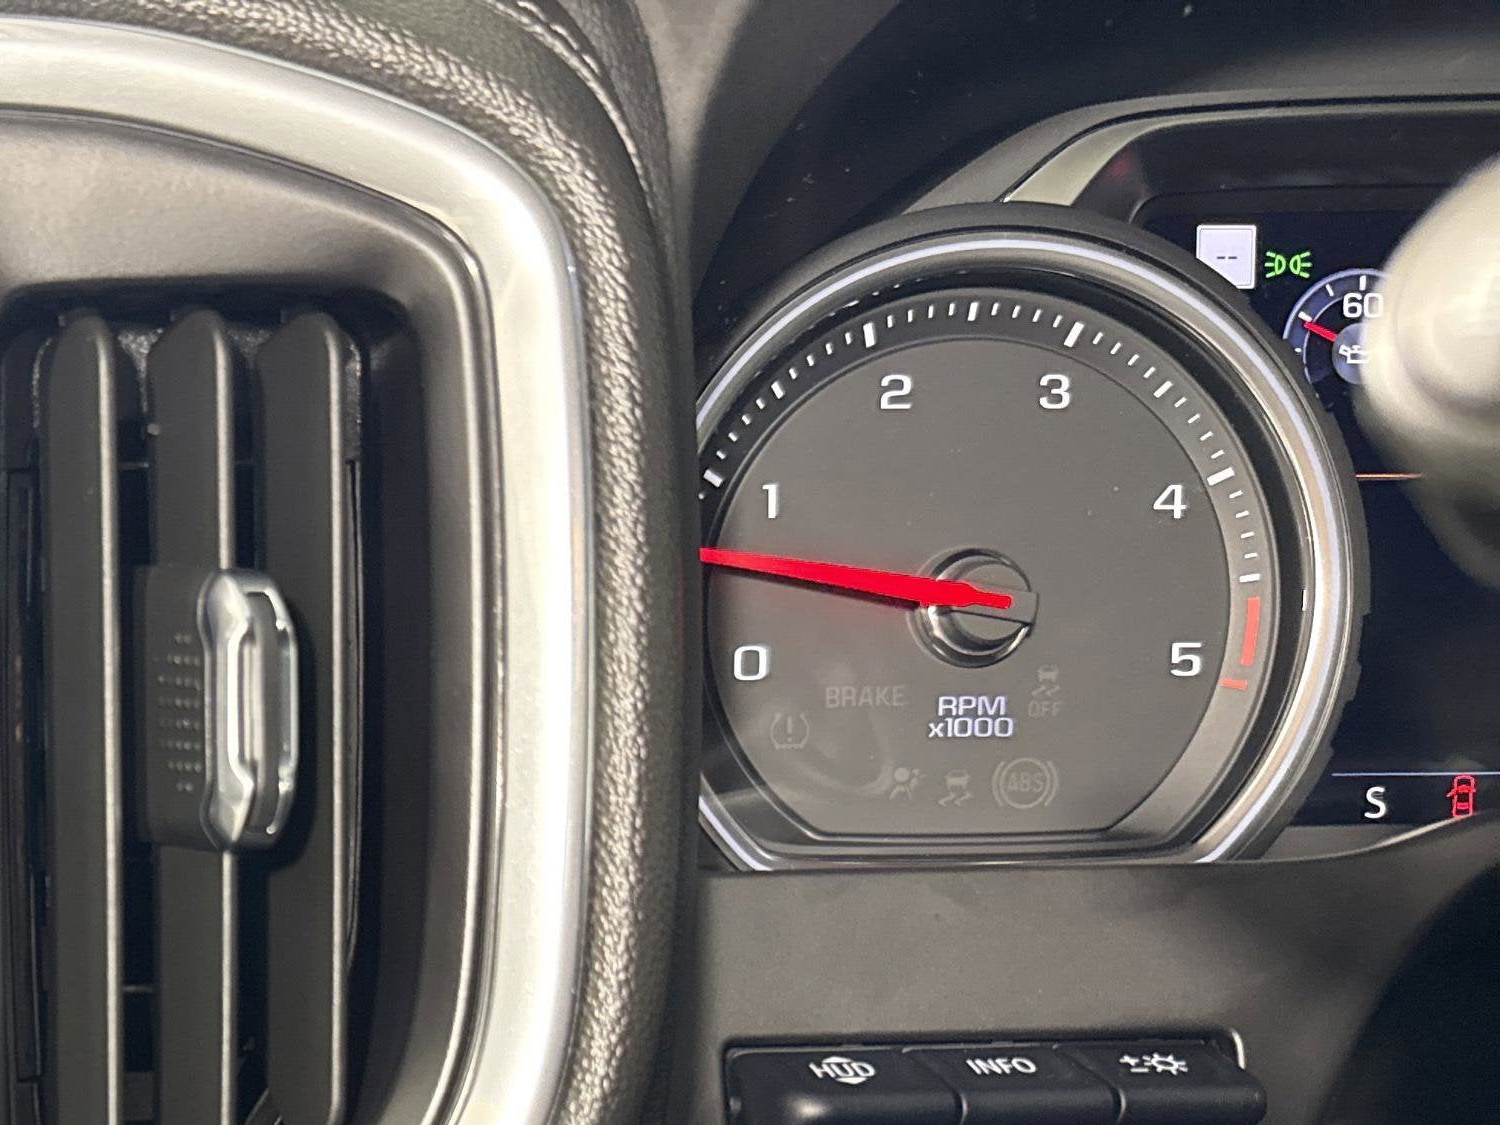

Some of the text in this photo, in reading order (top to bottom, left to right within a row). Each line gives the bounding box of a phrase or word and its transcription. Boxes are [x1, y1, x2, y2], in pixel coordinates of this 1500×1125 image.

[1343, 292, 1384, 319] 60
[880, 374, 912, 411] 2
[1039, 373, 1071, 410] 3
[762, 483, 779, 519] 1
[1153, 484, 1188, 519] 4
[733, 644, 769, 682] 0
[1170, 641, 1203, 677] 5
[824, 685, 907, 709] BRAKE
[938, 695, 1006, 716] RPM
[1028, 700, 1061, 718] OFF
[928, 717, 1014, 738] x1000
[1007, 770, 1045, 793] ABS
[1363, 786, 1388, 819] S
[808, 1060, 877, 1079] HUD
[966, 1056, 1037, 1076] INFO
